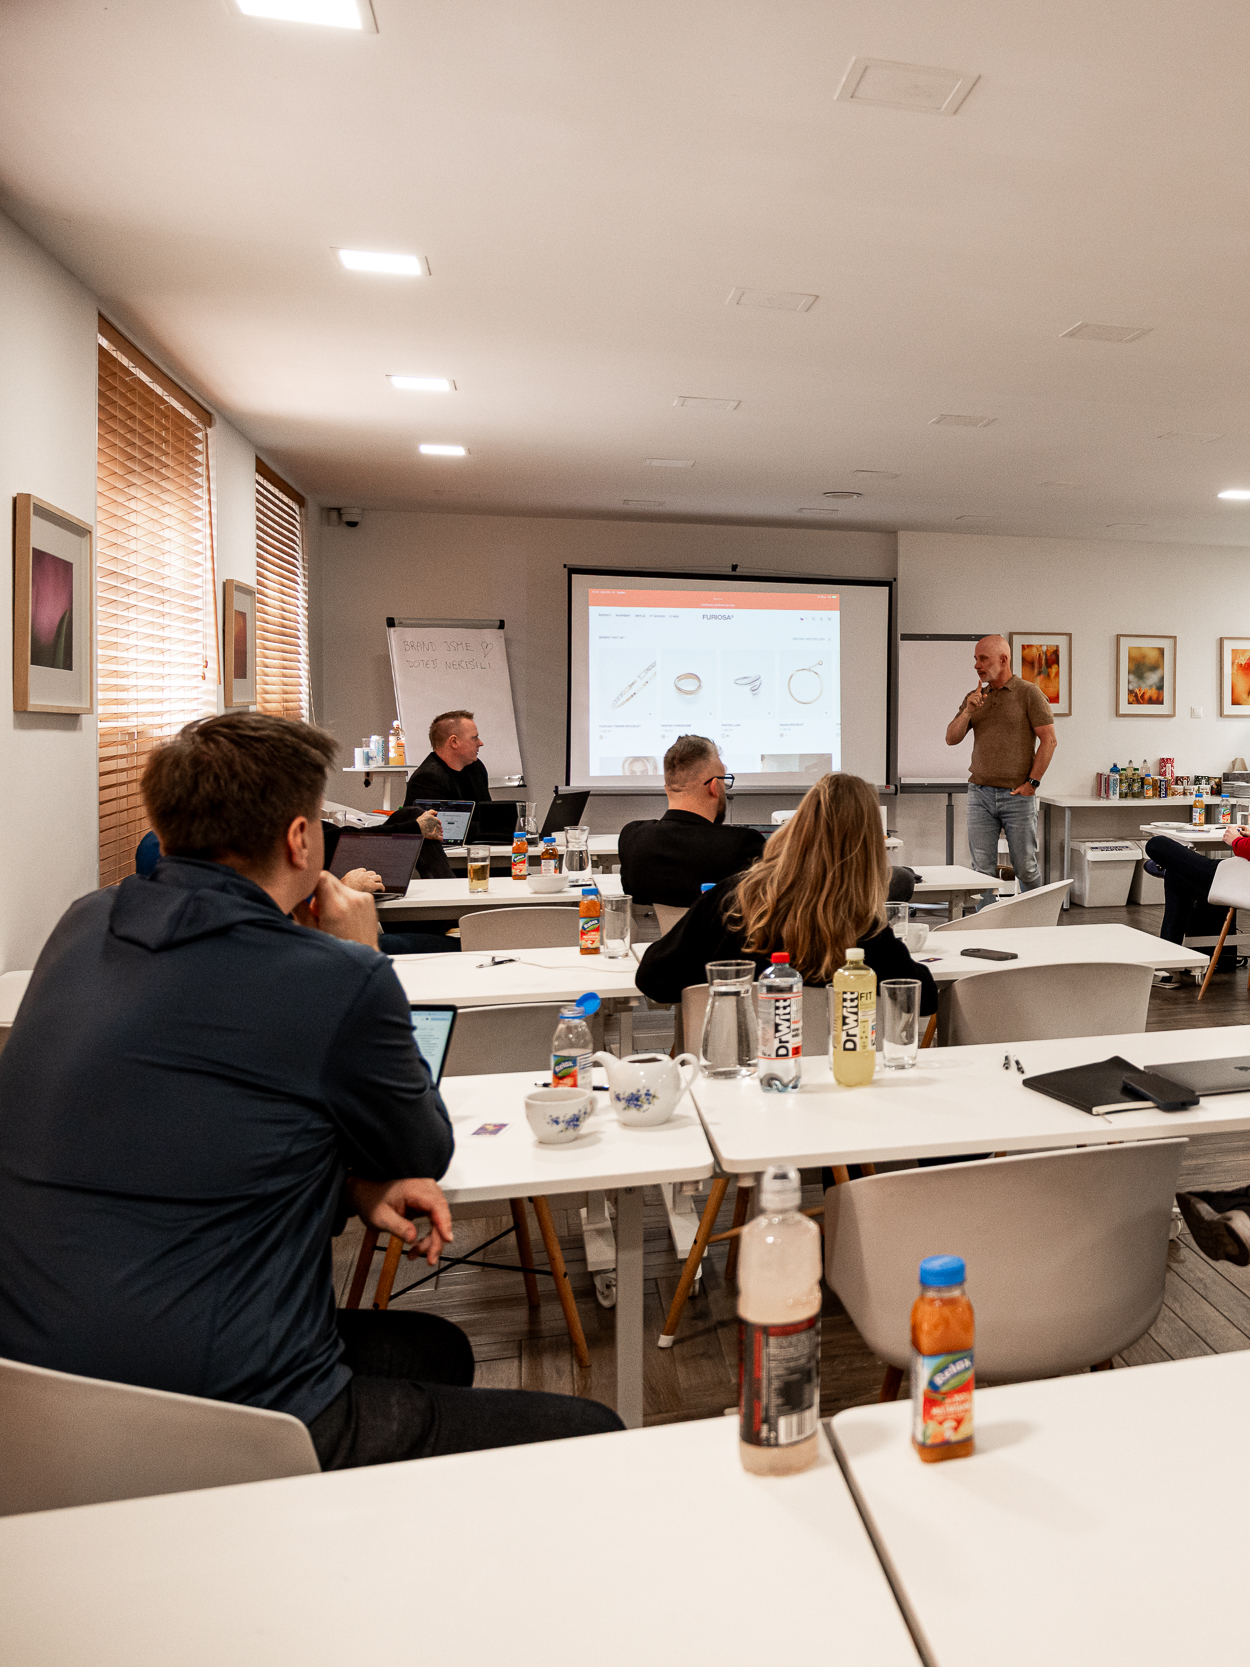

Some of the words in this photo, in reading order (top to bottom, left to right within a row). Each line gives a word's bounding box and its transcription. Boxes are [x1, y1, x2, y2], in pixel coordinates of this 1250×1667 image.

[403, 640, 437, 652] BRAND
[859, 991, 873, 1001] FIT
[774, 998, 791, 1058] DrWitt
[842, 991, 859, 1051] DrWitt
[933, 1358, 973, 1387] Relax
